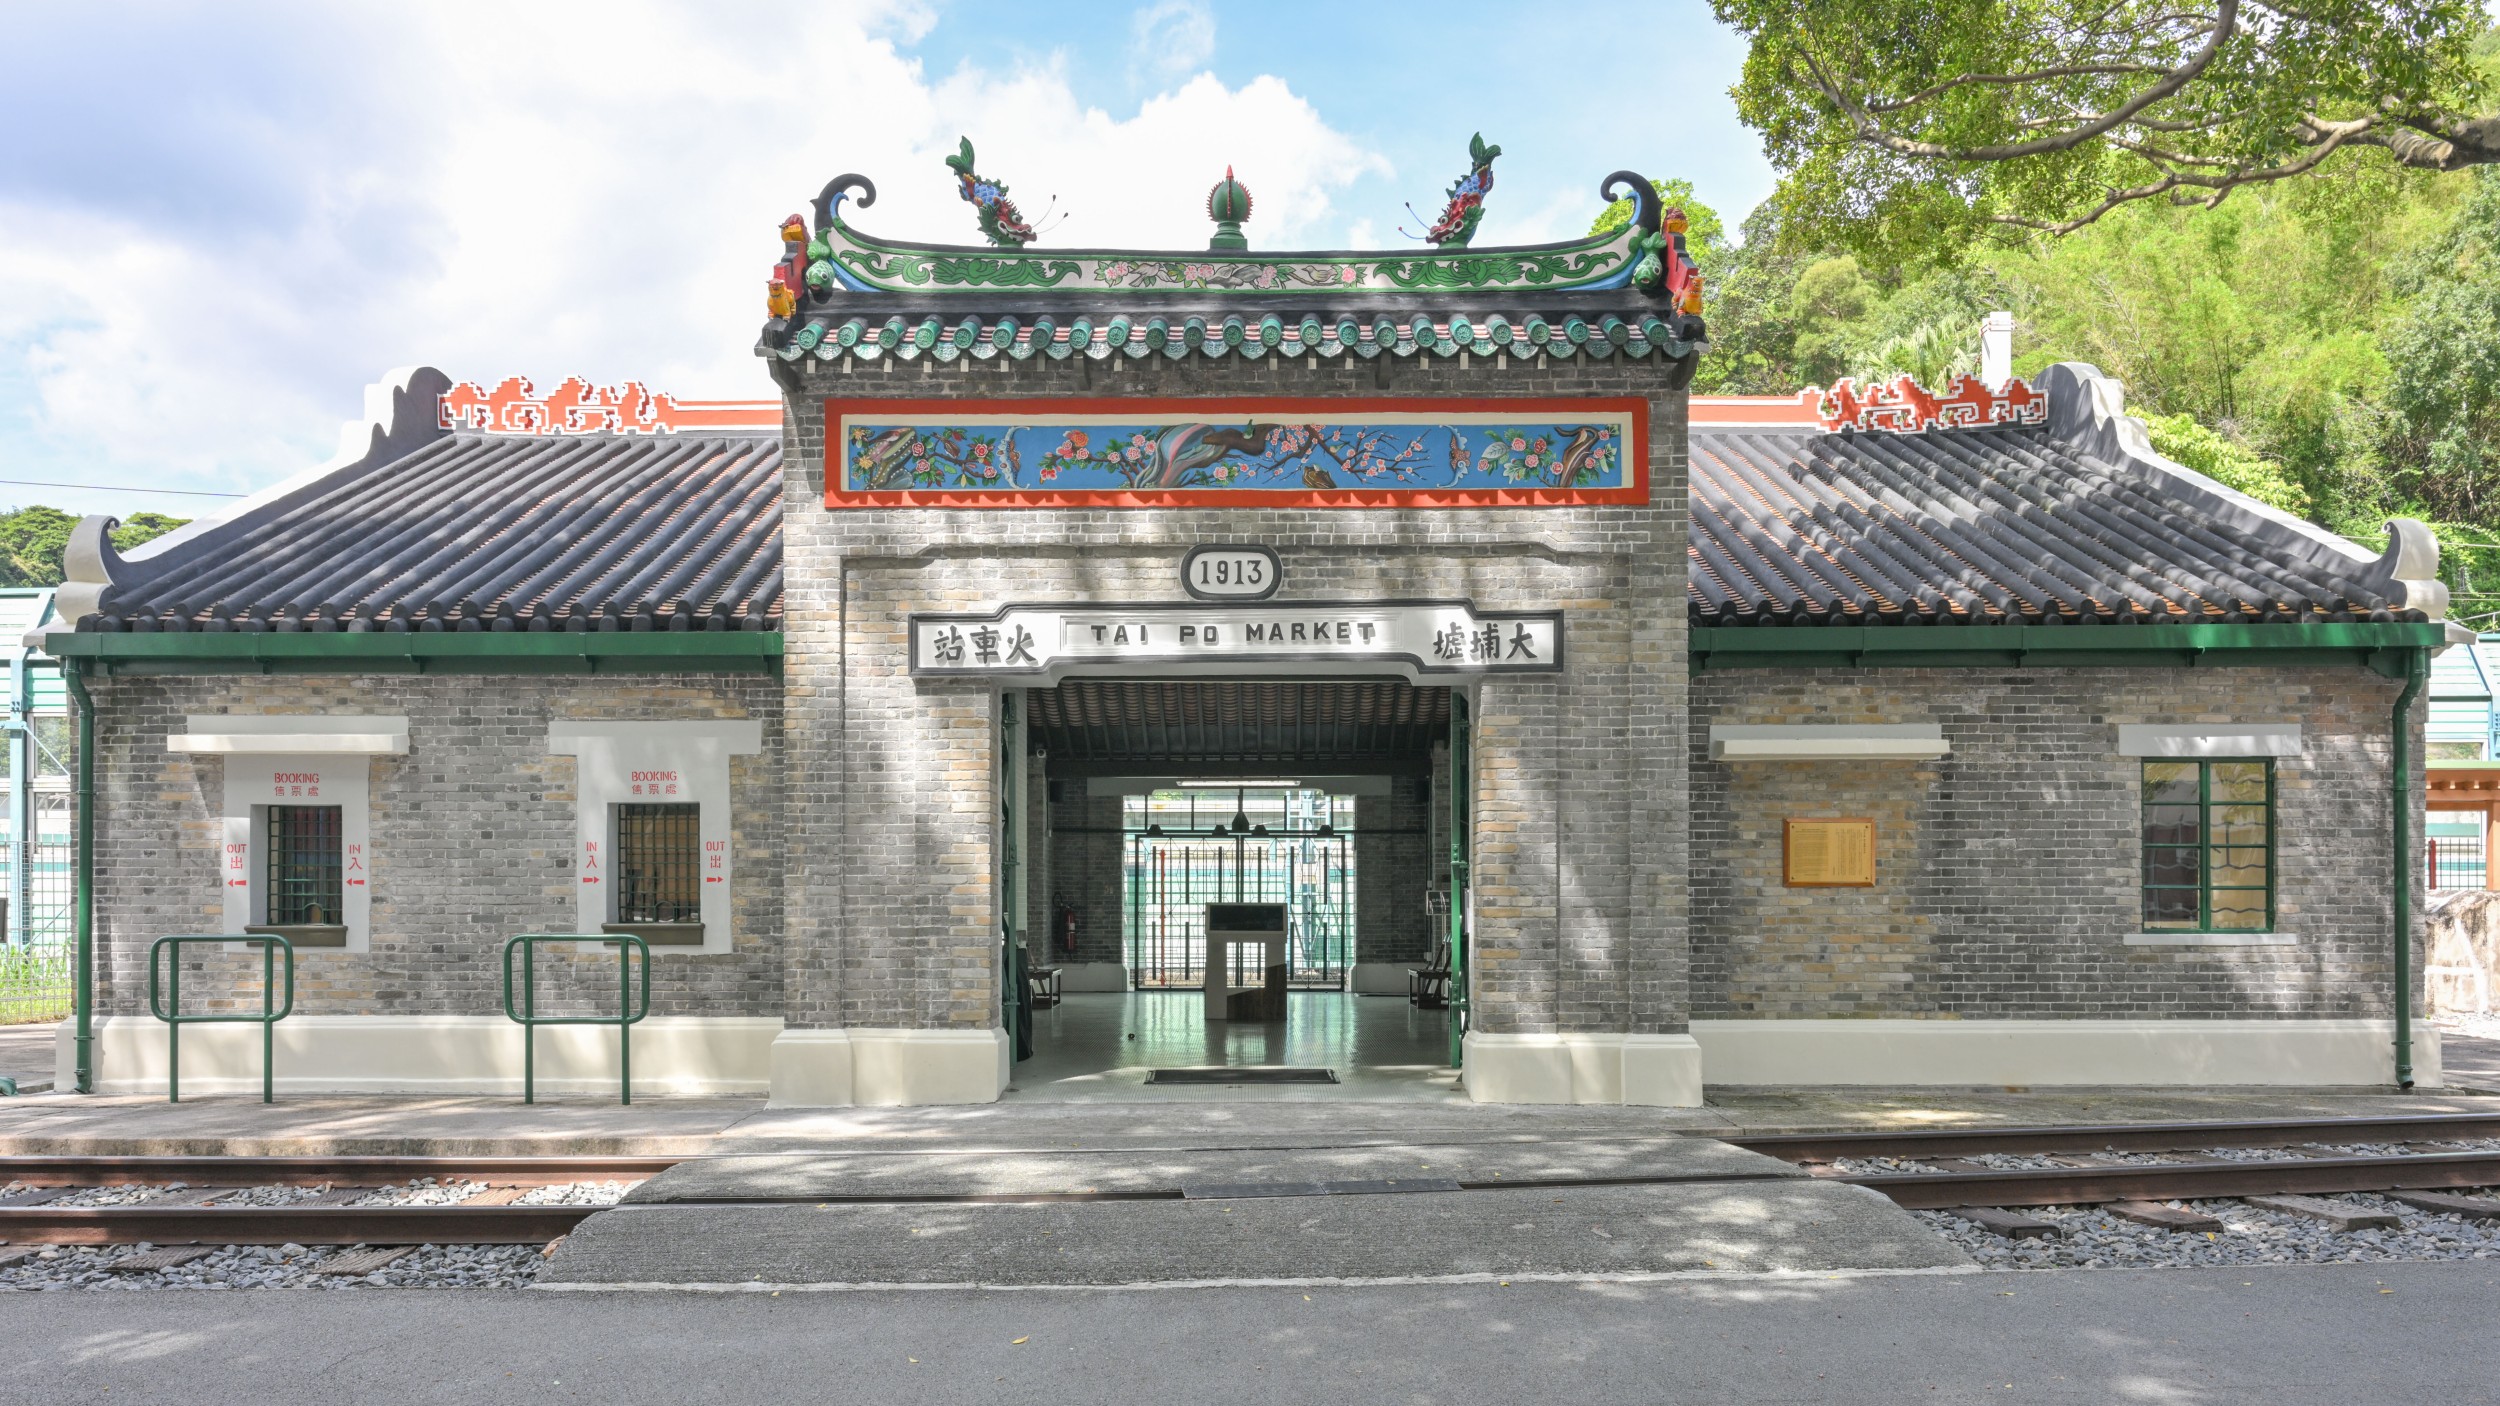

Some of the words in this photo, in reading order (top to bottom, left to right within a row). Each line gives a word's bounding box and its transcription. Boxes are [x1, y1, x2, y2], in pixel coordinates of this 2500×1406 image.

[1200, 560, 1263, 585] 1913
[1091, 625, 1146, 642] TAI
[1179, 625, 1217, 642] PO
[1246, 622, 1375, 642] MARKET
[274, 772, 320, 784] BOOKING
[631, 771, 678, 782] BOOKING
[227, 844, 247, 854] OUT
[349, 844, 361, 854] IN
[586, 841, 598, 852] IN
[706, 841, 726, 852] OUT
[230, 856, 243, 870] 出
[348, 857, 363, 870] 入
[586, 855, 598, 869] 入
[710, 855, 721, 869] 出
